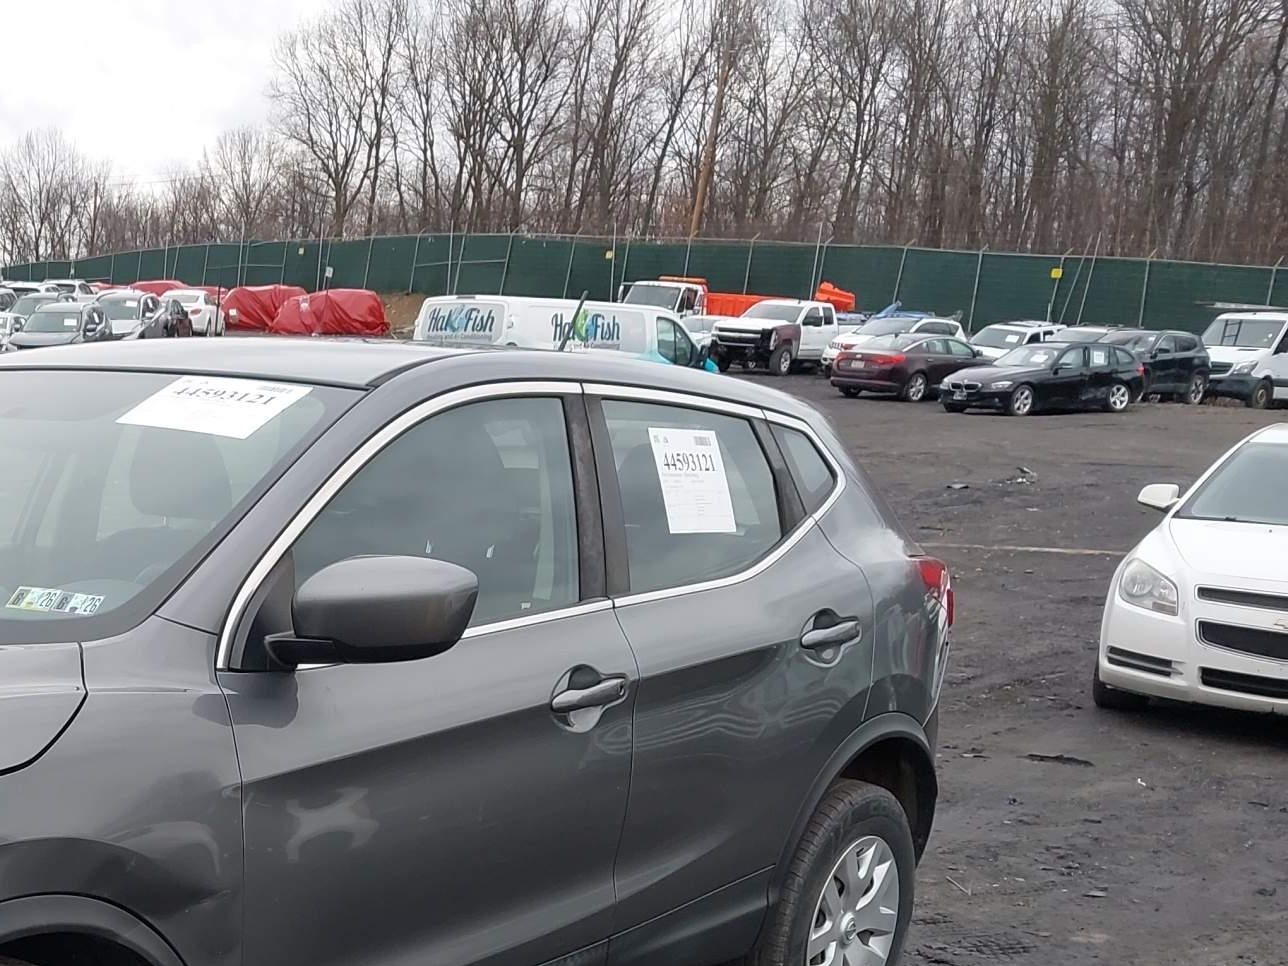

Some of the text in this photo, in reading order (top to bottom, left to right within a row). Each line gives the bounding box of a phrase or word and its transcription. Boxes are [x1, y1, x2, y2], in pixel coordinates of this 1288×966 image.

[464, 307, 495, 333] Fish
[592, 313, 620, 341] Fish
[171, 386, 276, 405] 44593121
[663, 451, 716, 472] 44593121
